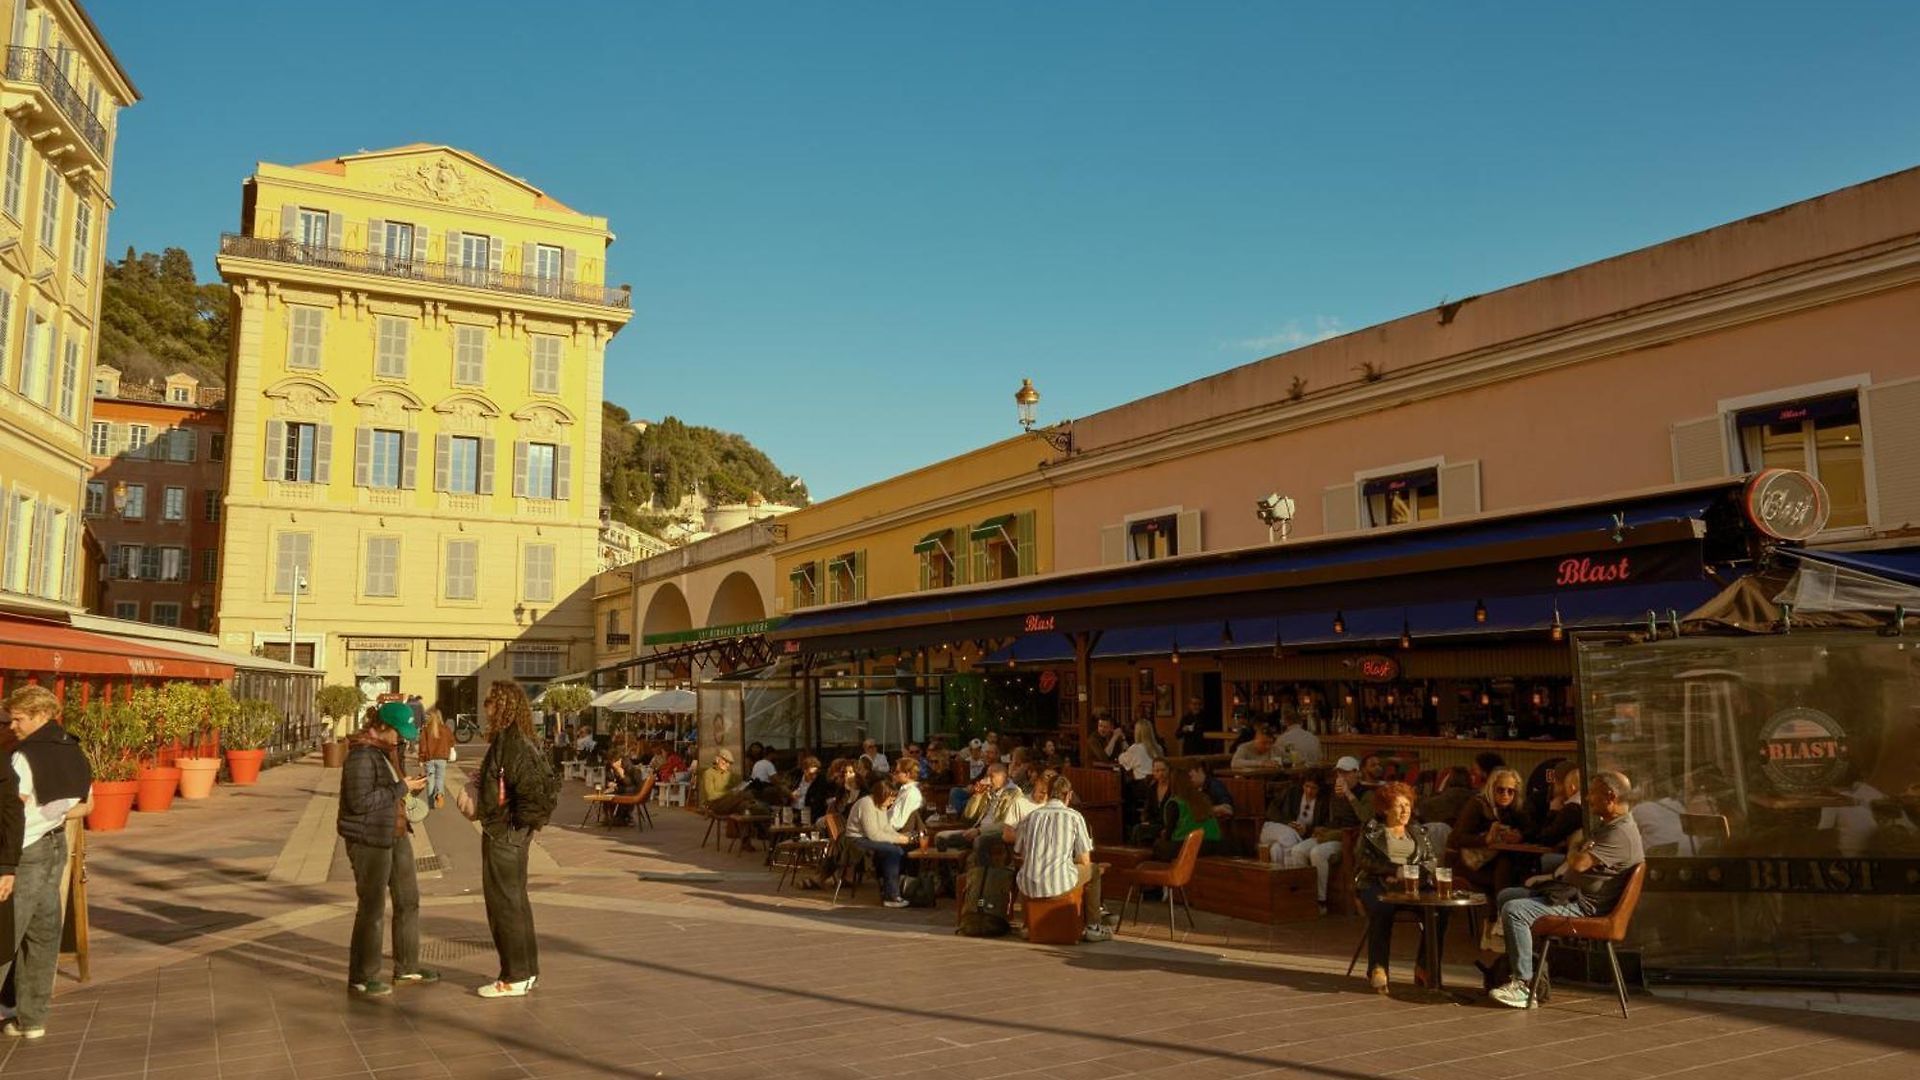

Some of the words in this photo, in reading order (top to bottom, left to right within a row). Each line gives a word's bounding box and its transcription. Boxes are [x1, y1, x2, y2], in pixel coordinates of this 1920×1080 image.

[1556, 557, 1631, 586] Blast
[1025, 614, 1055, 633] Blast
[1363, 660, 1391, 677] Blast
[1768, 740, 1837, 761] BLAST
[1748, 859, 1879, 891] BLAST
